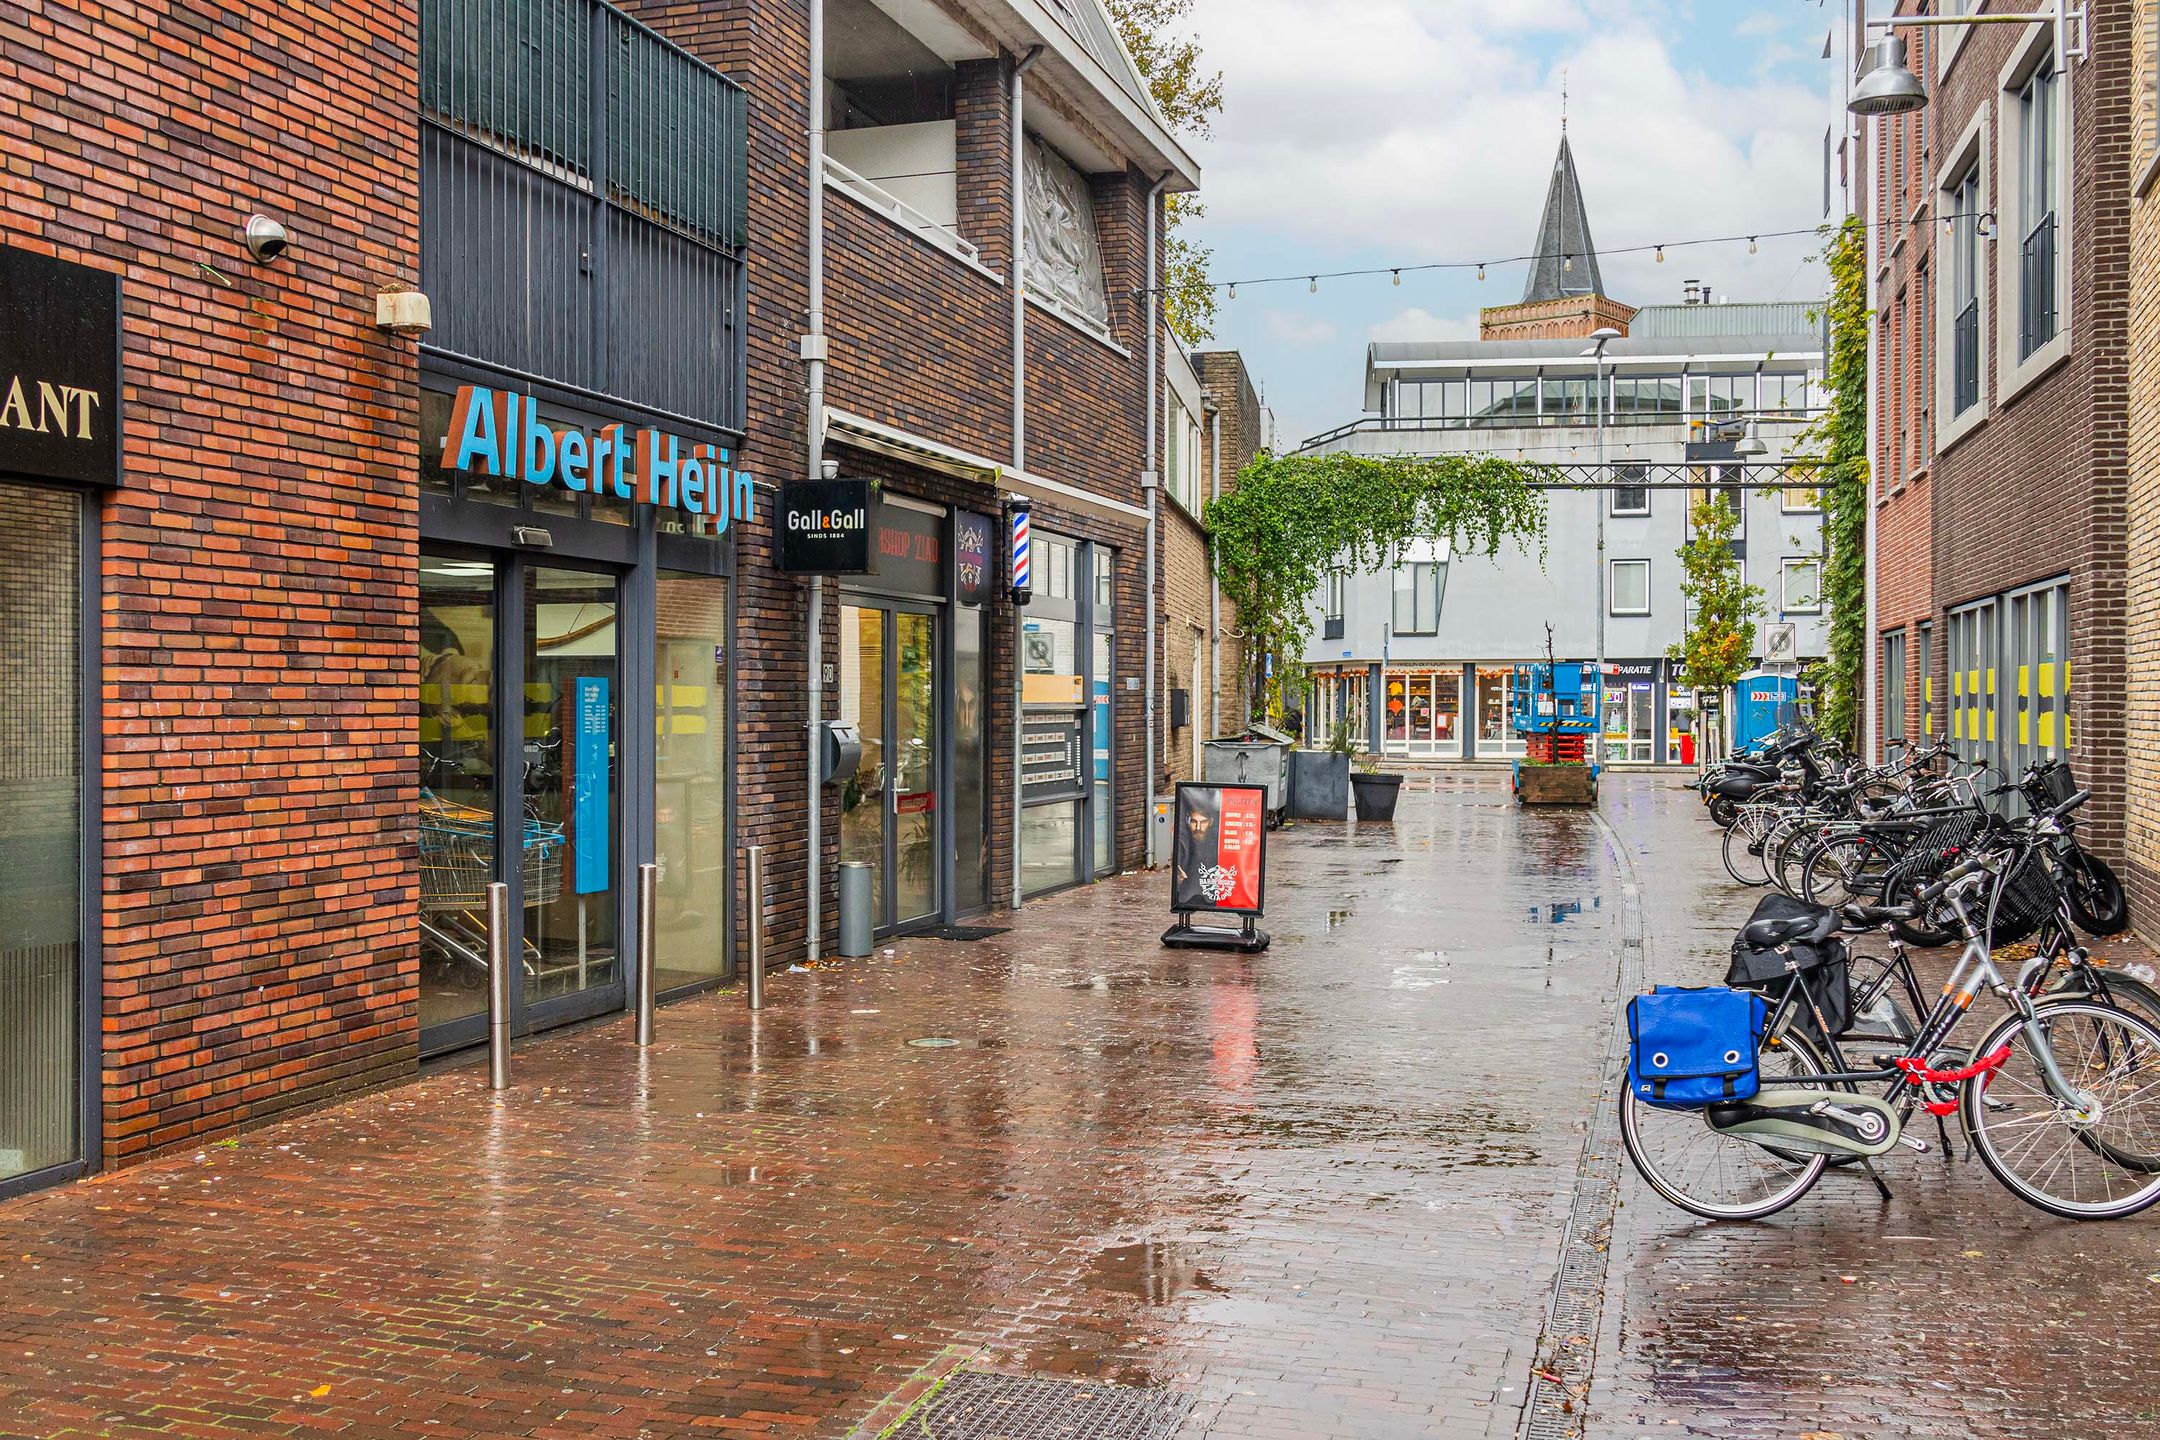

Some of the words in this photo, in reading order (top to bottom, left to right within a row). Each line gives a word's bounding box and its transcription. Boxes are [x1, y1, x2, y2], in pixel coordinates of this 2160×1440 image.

[0, 374, 100, 440] ANT
[450, 385, 632, 500] Albert
[640, 429, 754, 535] Heijn
[787, 508, 865, 531] Gall&Gall
[823, 666, 833, 681] 90
